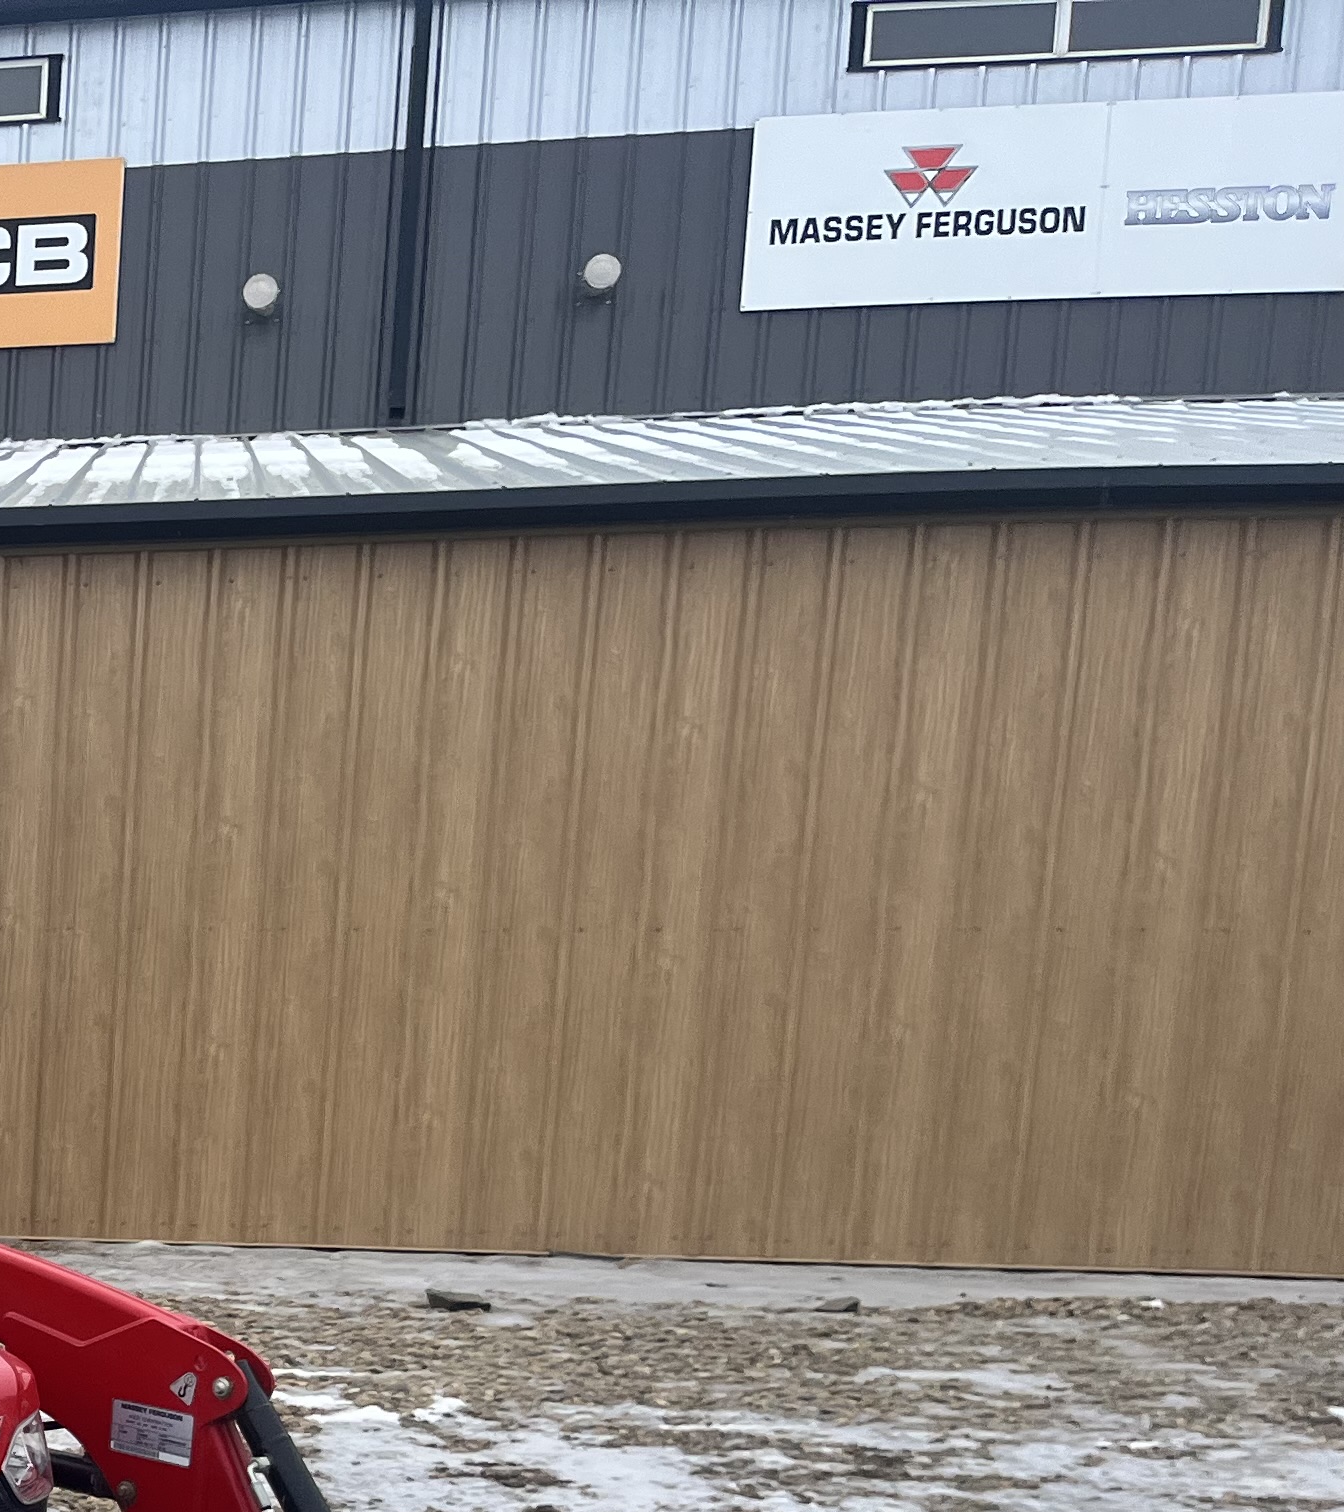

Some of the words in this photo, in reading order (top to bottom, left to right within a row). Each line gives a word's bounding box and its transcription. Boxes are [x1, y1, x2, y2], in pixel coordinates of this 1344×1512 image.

[768, 211, 907, 246] MASSEY
[915, 205, 1087, 240] FERGUSON
[1123, 183, 1338, 227] HESSTON
